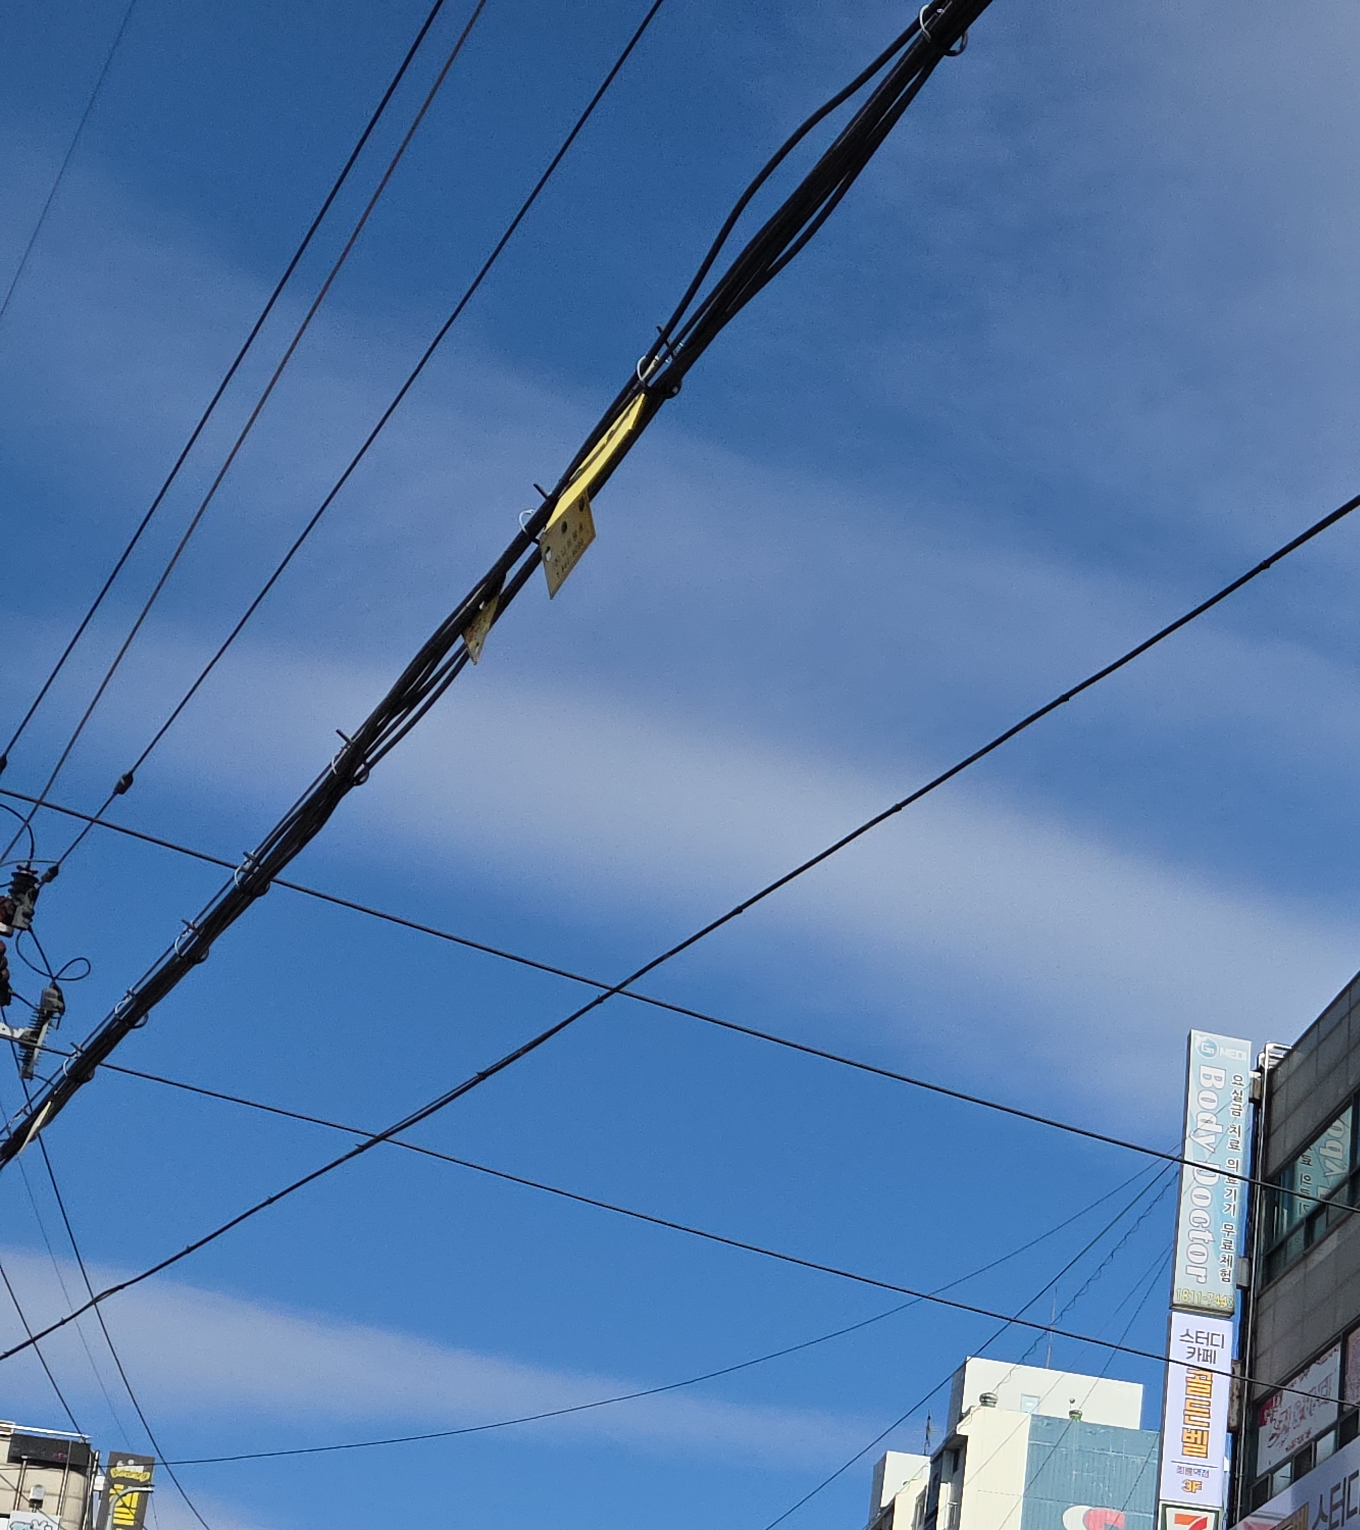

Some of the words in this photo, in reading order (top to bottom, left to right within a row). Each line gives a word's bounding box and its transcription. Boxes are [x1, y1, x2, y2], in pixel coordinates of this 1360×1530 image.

[1189, 1064, 1227, 1156] Body
[1185, 1159, 1222, 1286] Doctor
[1179, 1330, 1225, 1350] 스터디
[1186, 1346, 1218, 1365] 카페
[1181, 1479, 1203, 1493] 3F
